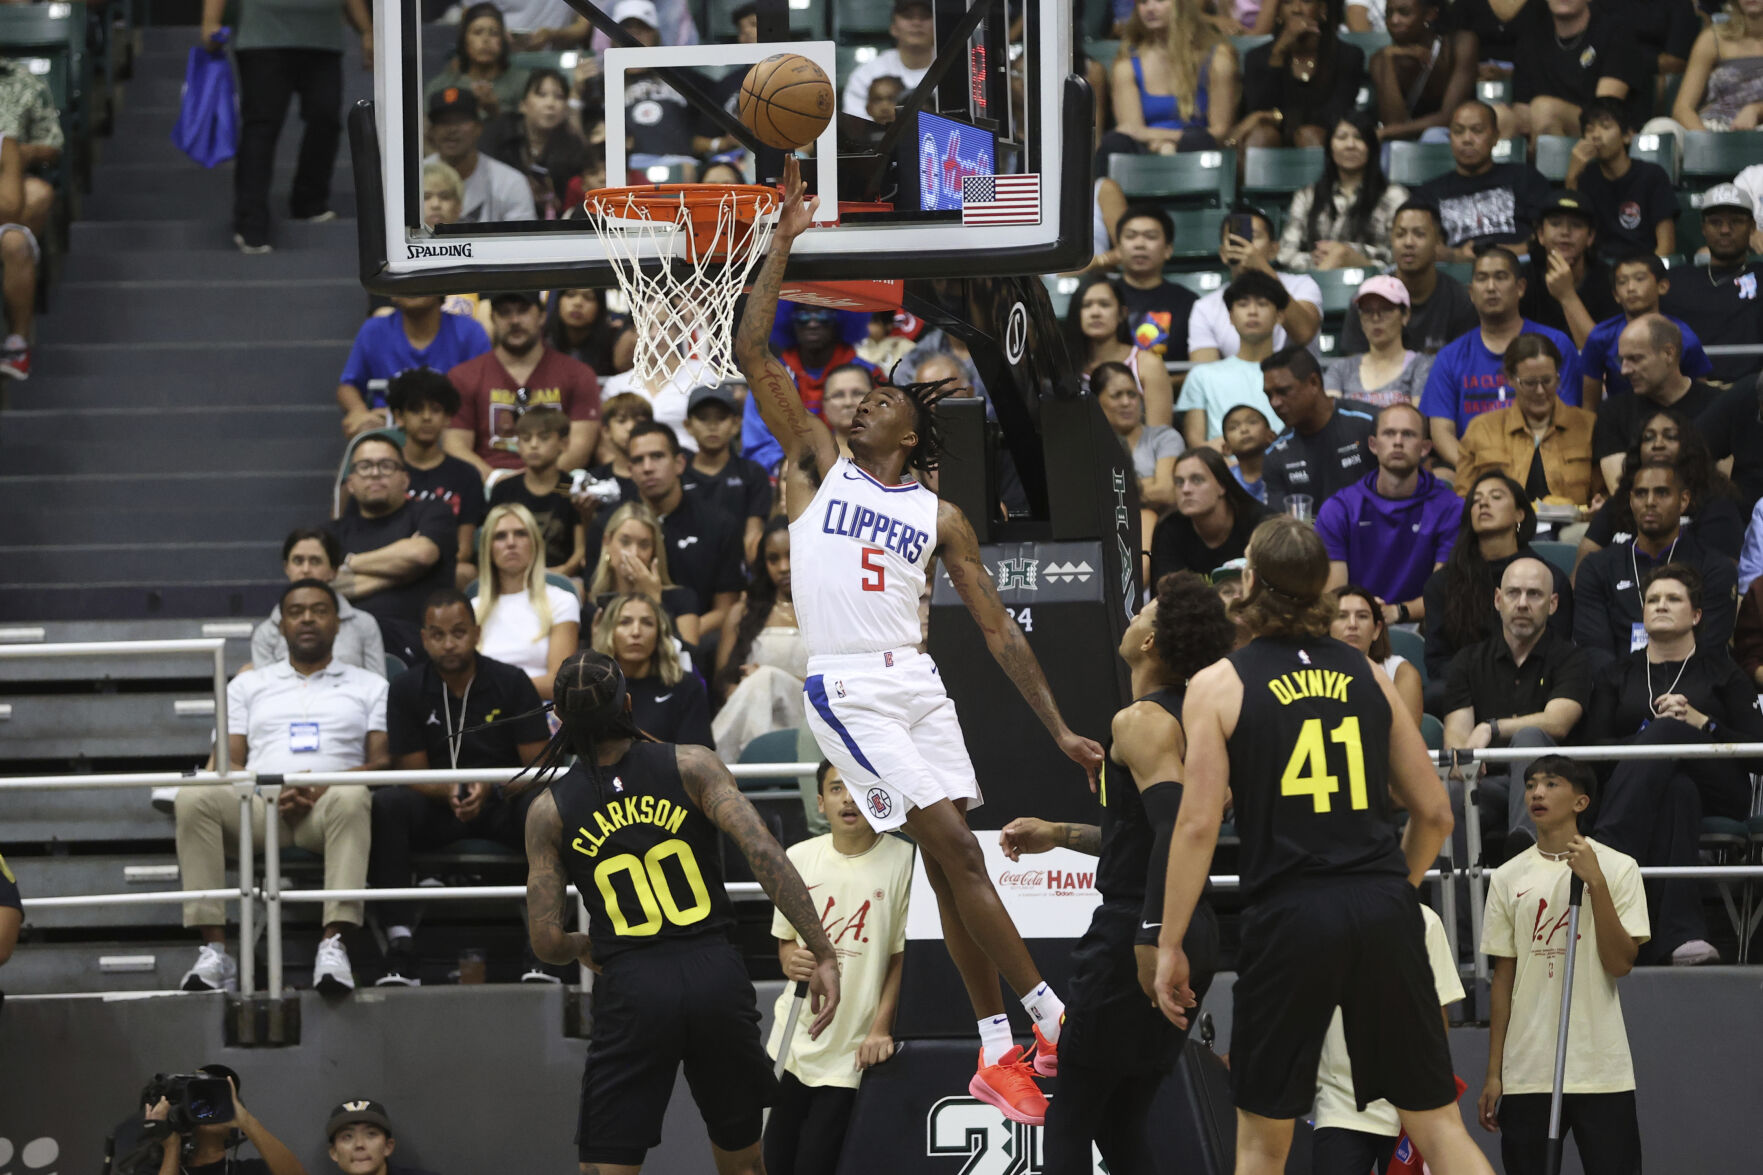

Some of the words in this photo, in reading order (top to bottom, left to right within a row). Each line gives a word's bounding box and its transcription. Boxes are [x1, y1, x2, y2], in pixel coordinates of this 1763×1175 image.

[407, 243, 472, 259] SPALDING
[822, 499, 929, 564] CLIPPERS
[862, 547, 885, 592] 5
[1268, 669, 1354, 705] OLYNYK
[1281, 716, 1369, 813] 41
[572, 796, 688, 858] CLARKSON
[594, 839, 711, 936] 00
[1047, 870, 1097, 889] HAW
